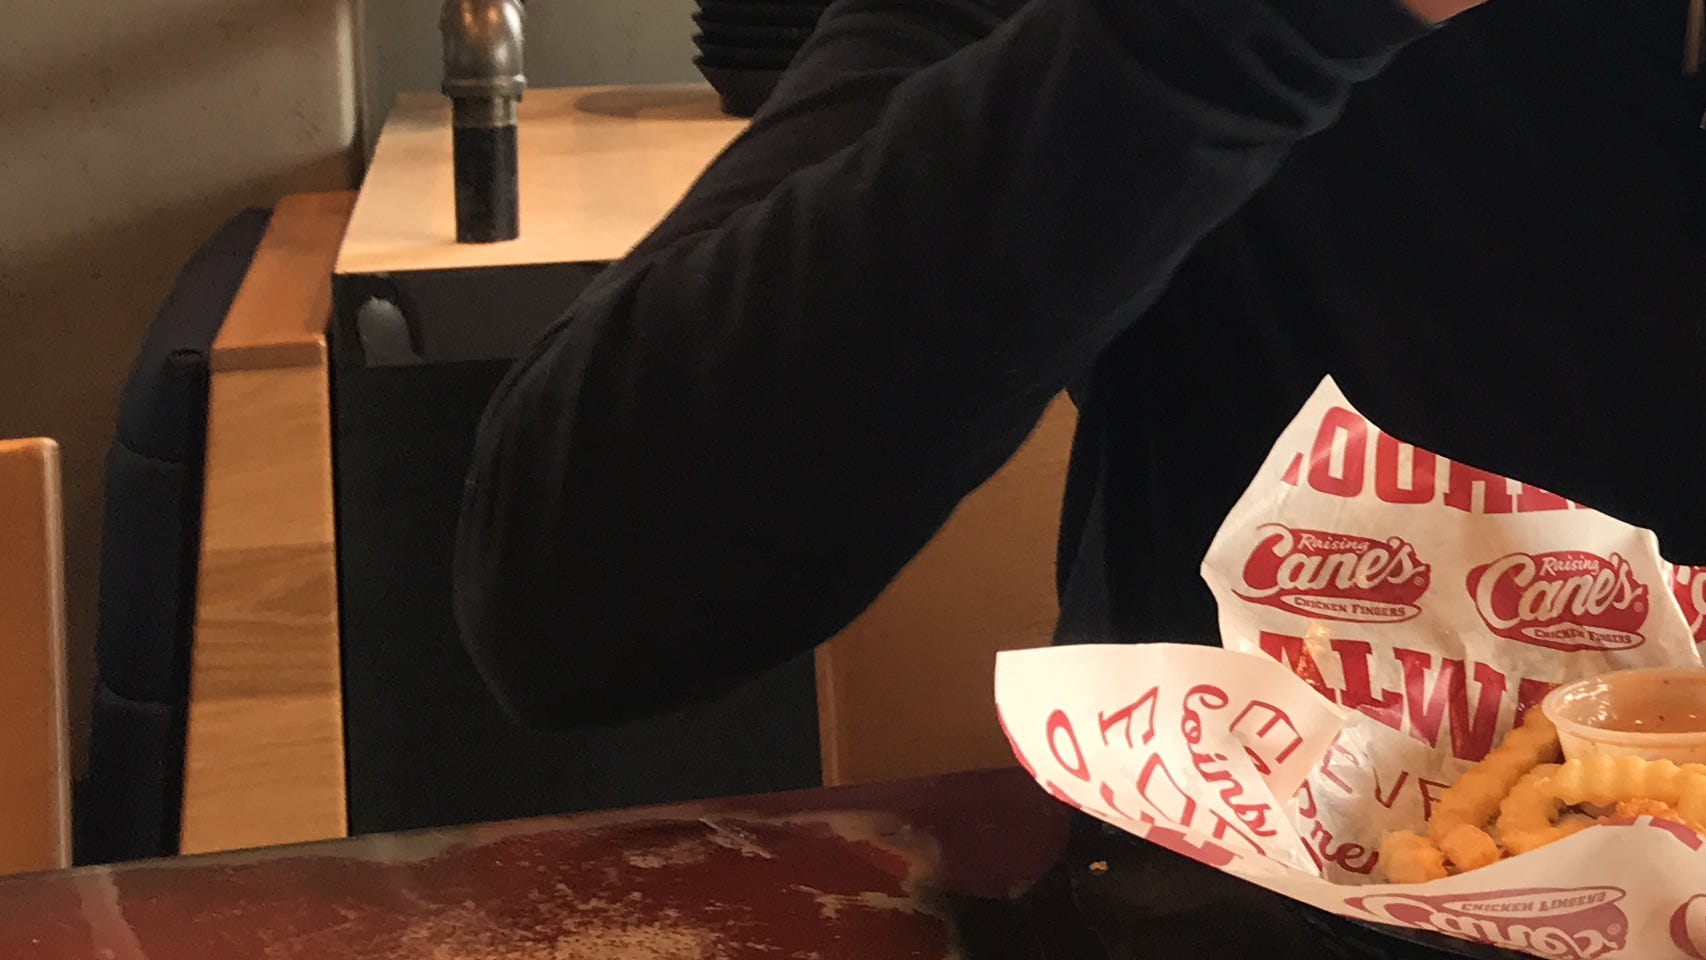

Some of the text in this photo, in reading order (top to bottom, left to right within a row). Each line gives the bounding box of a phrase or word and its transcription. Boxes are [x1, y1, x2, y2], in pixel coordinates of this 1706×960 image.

[1298, 533, 1371, 553] Raising
[1233, 523, 1427, 599] Cane's
[1539, 555, 1600, 576] Raising
[1476, 552, 1644, 630] Cane's
[1294, 596, 1406, 618] CHICKEN FINGERS
